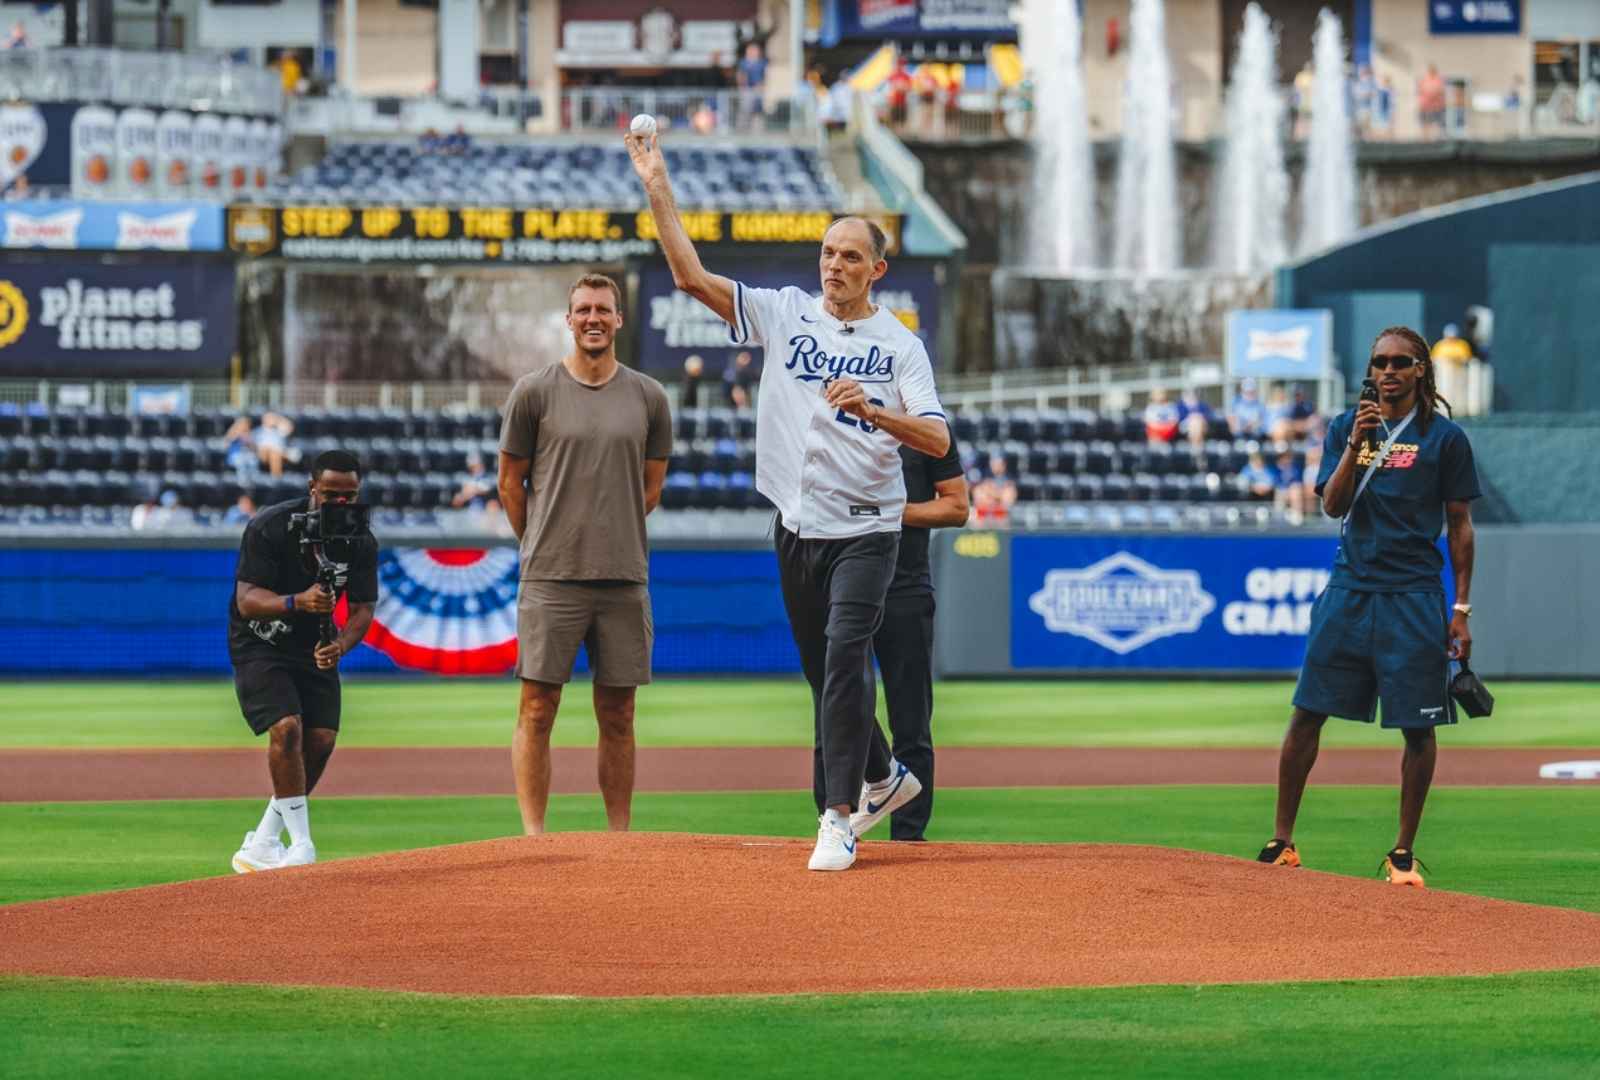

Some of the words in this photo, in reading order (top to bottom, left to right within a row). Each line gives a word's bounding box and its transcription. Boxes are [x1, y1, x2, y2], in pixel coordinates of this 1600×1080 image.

[282, 207, 351, 237] STEP
[362, 207, 400, 238] UP
[413, 207, 450, 239] TO
[461, 208, 513, 239] THE
[523, 208, 623, 240] PLATE.
[636, 211, 721, 240] SVE
[40, 278, 175, 326] planet
[58, 315, 203, 350] fitness
[785, 334, 894, 386] Royals
